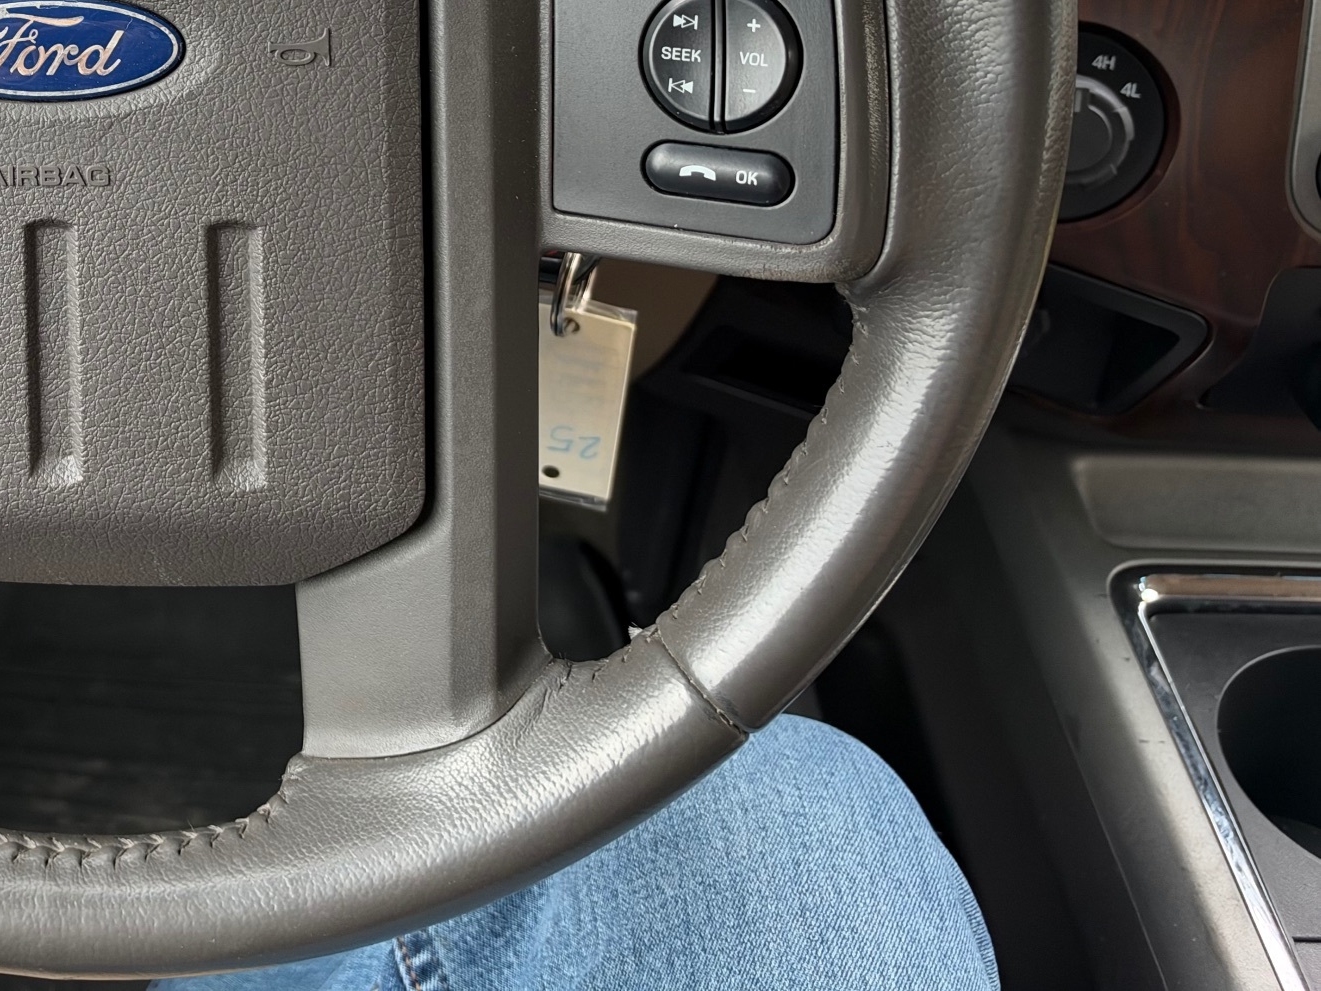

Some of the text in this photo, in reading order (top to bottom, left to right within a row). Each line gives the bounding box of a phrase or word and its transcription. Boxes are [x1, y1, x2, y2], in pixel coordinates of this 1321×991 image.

[660, 46, 702, 63] SEEK
[739, 51, 769, 67] VOL
[1091, 54, 1116, 71] 4H
[1119, 82, 1142, 99] 4L
[735, 169, 758, 187] OK
[546, 424, 601, 461] 25
